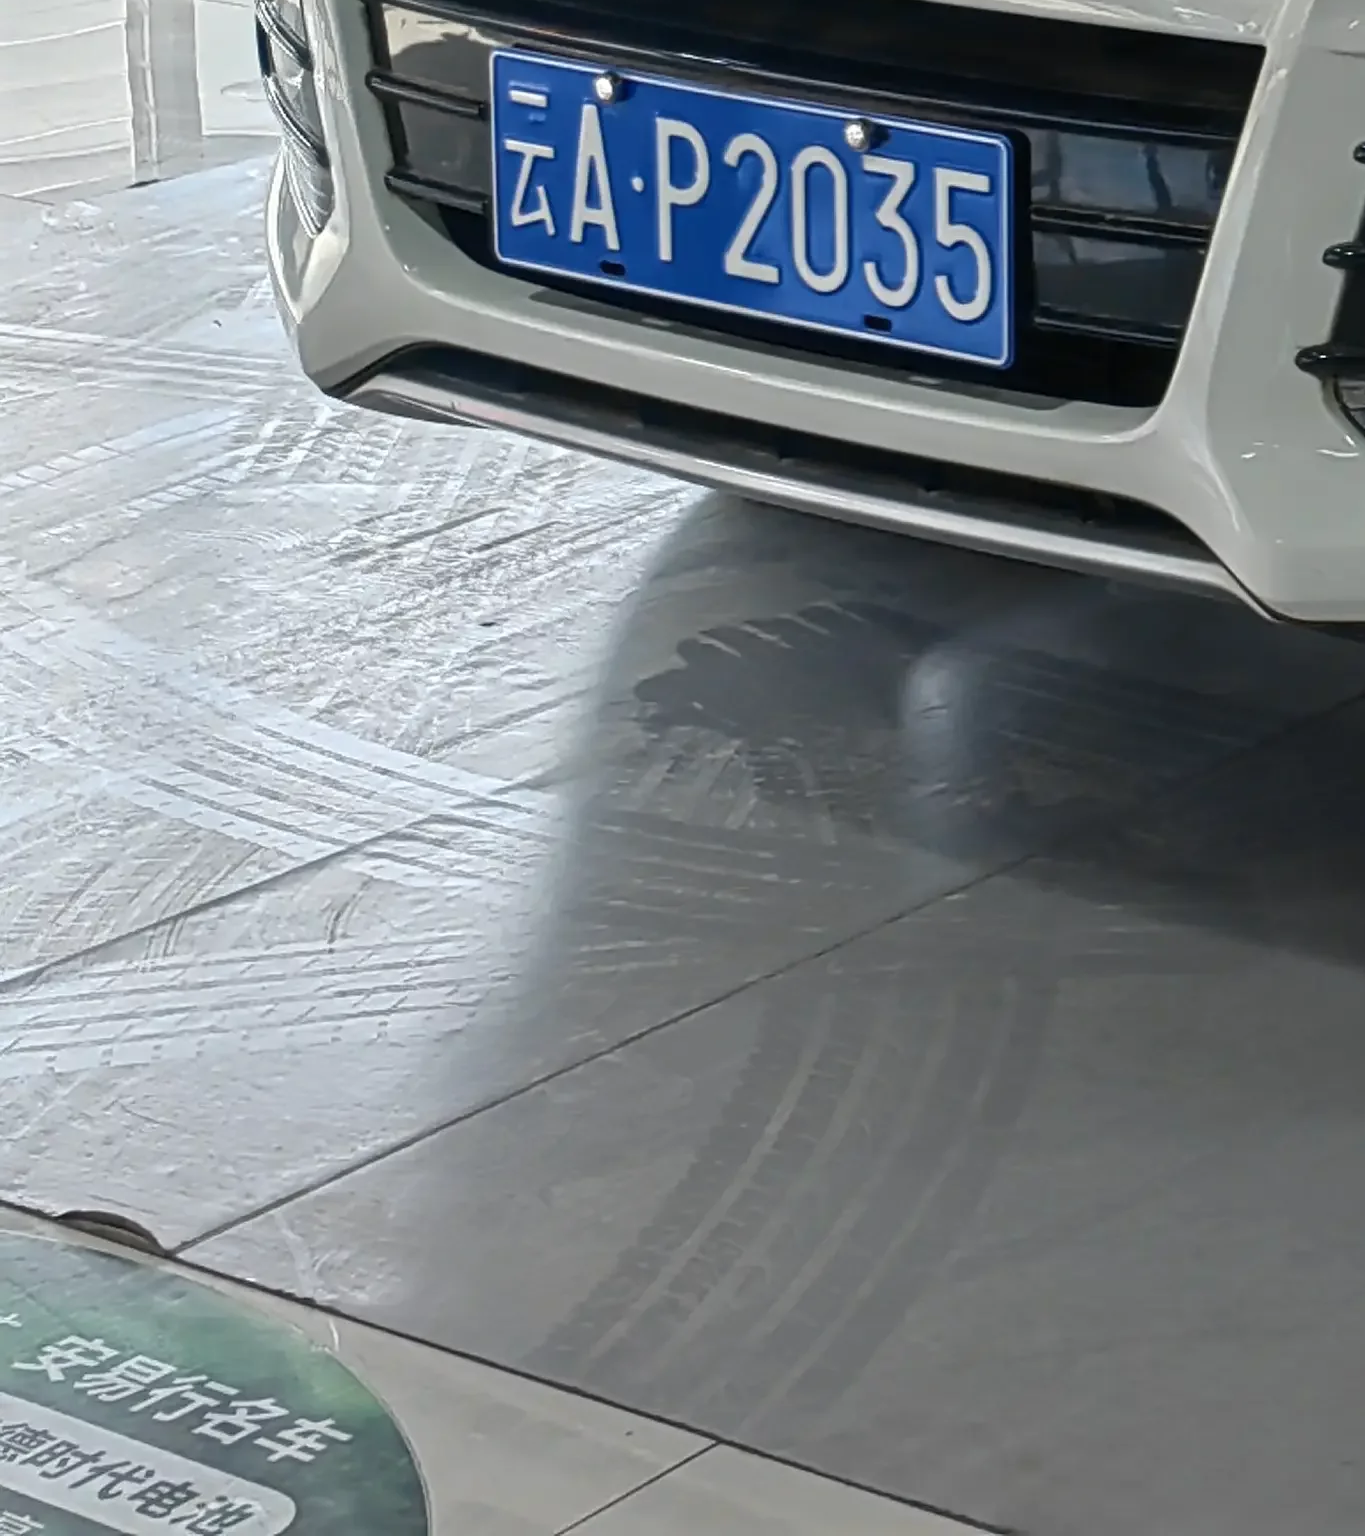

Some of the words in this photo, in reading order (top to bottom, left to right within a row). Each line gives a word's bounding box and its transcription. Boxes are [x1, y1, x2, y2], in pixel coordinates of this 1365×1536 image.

[12, 1334, 354, 1463] 安易行名车
